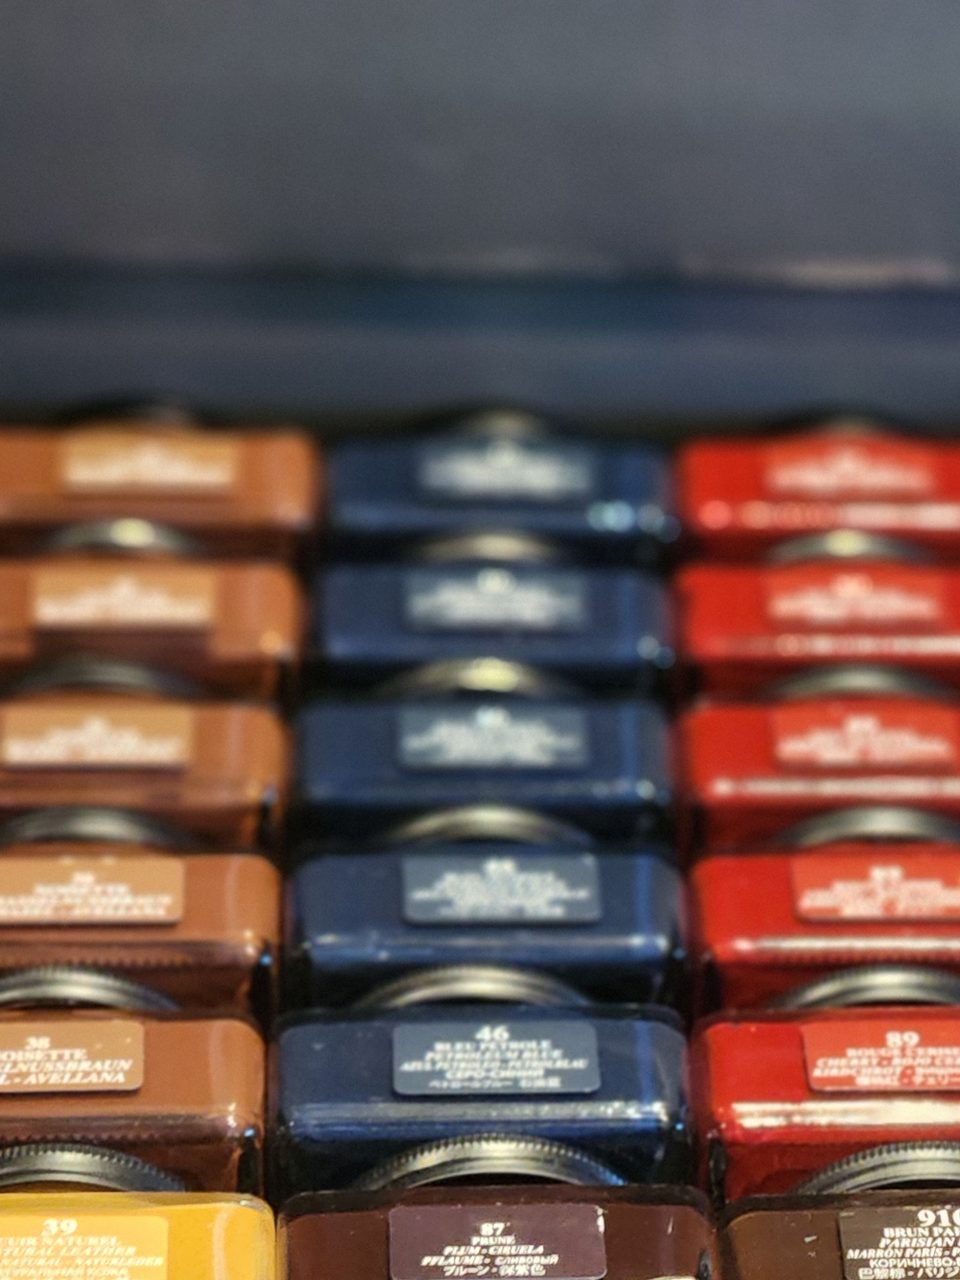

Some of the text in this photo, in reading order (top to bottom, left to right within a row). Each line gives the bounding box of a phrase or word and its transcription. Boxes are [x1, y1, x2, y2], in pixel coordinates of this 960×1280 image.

[476, 1025, 509, 1041] 46
[885, 1031, 919, 1047] 89
[41, 1218, 77, 1236] 39
[480, 1222, 505, 1236] 87
[884, 1228, 931, 1237] BRUN
[879, 1237, 955, 1248] PARISIAN
[443, 1245, 544, 1255] PLUM CIRUELA
[421, 1256, 484, 1266] PFLAUME
